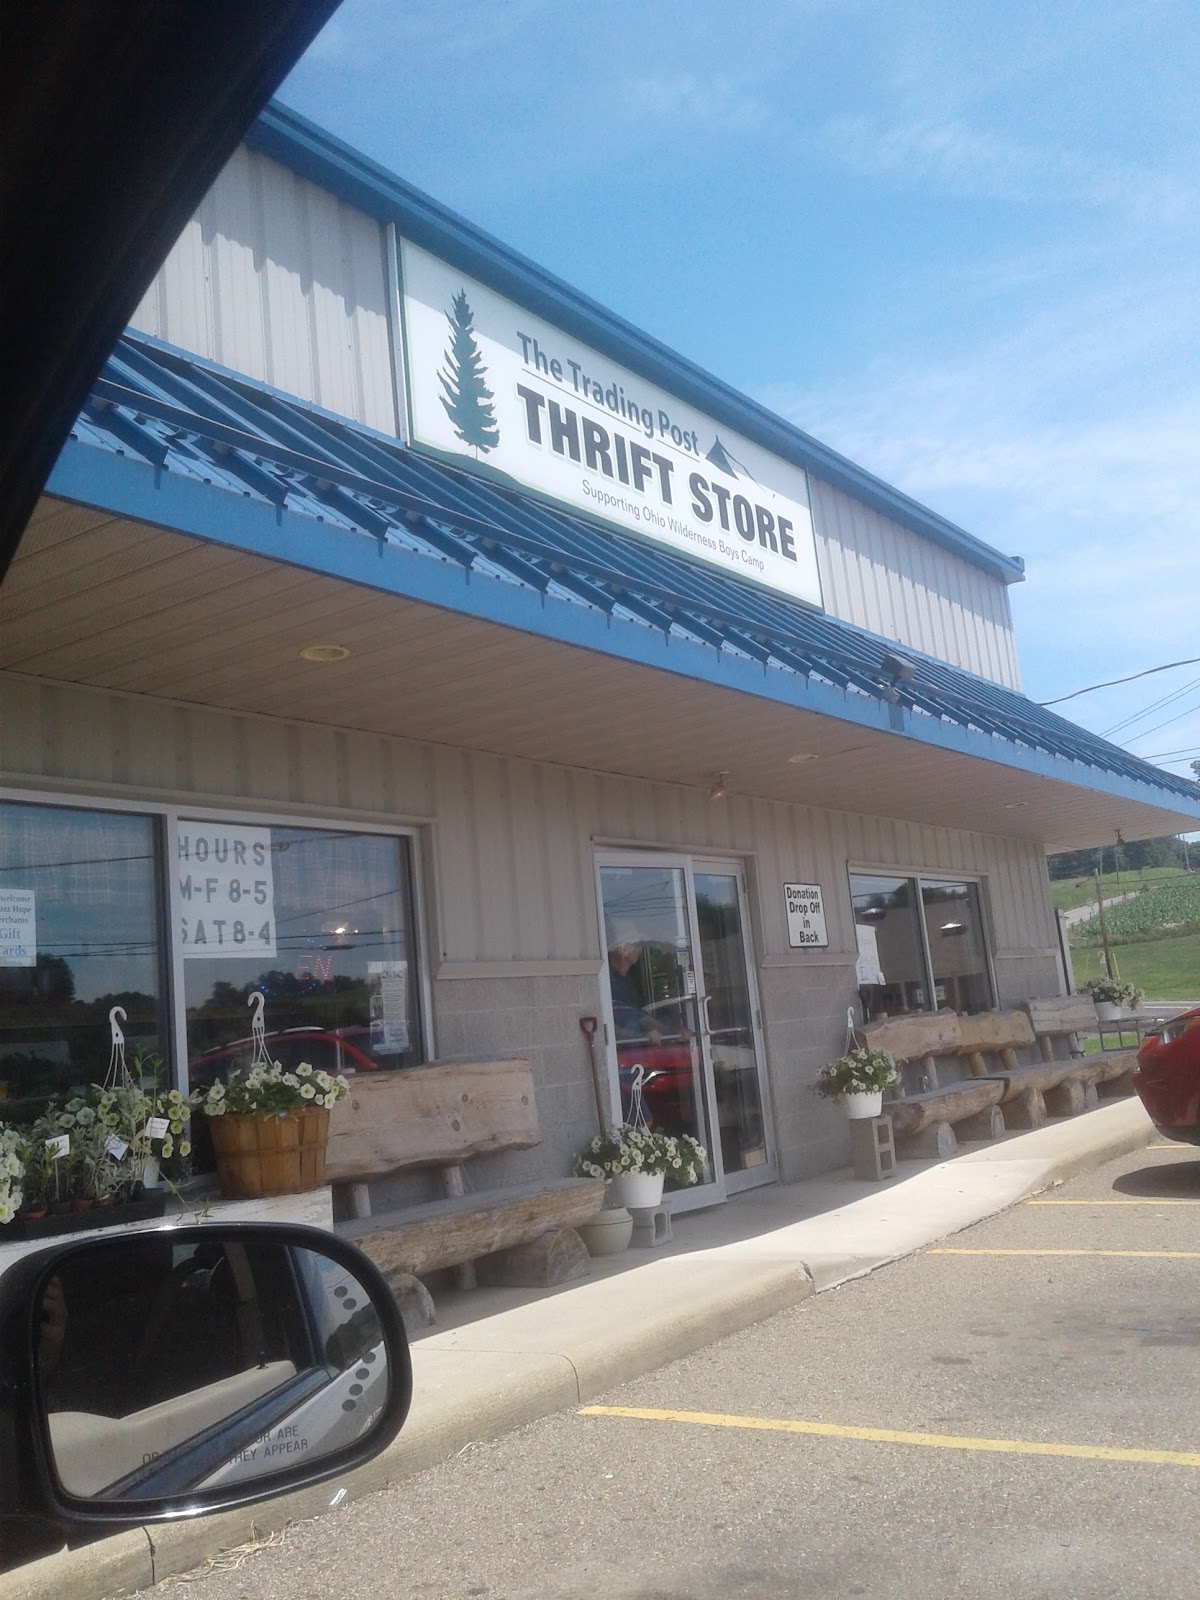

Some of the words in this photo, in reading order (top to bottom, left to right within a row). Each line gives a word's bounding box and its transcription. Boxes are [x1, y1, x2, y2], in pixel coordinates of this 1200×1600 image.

[516, 331, 563, 382] The
[566, 358, 655, 439] Trading
[657, 409, 700, 457] Post
[516, 382, 674, 505] THRIFT
[689, 472, 798, 562] STORE
[582, 479, 641, 521] Supporting
[642, 506, 666, 528] Ohio
[667, 517, 717, 550] Wilderness
[718, 539, 740, 561] Boys
[741, 551, 765, 572] Camp
[178, 835, 266, 867] HOURS
[228, 878, 268, 905] 8-5
[786, 886, 819, 900] Donation
[789, 901, 808, 917] Drop
[809, 901, 821, 914] Off
[802, 916, 811, 929] in
[799, 930, 820, 943] Back
[0, 945, 27, 956] ards
[276, 1425, 300, 1438] ARE
[263, 1438, 309, 1458] APPEAR
